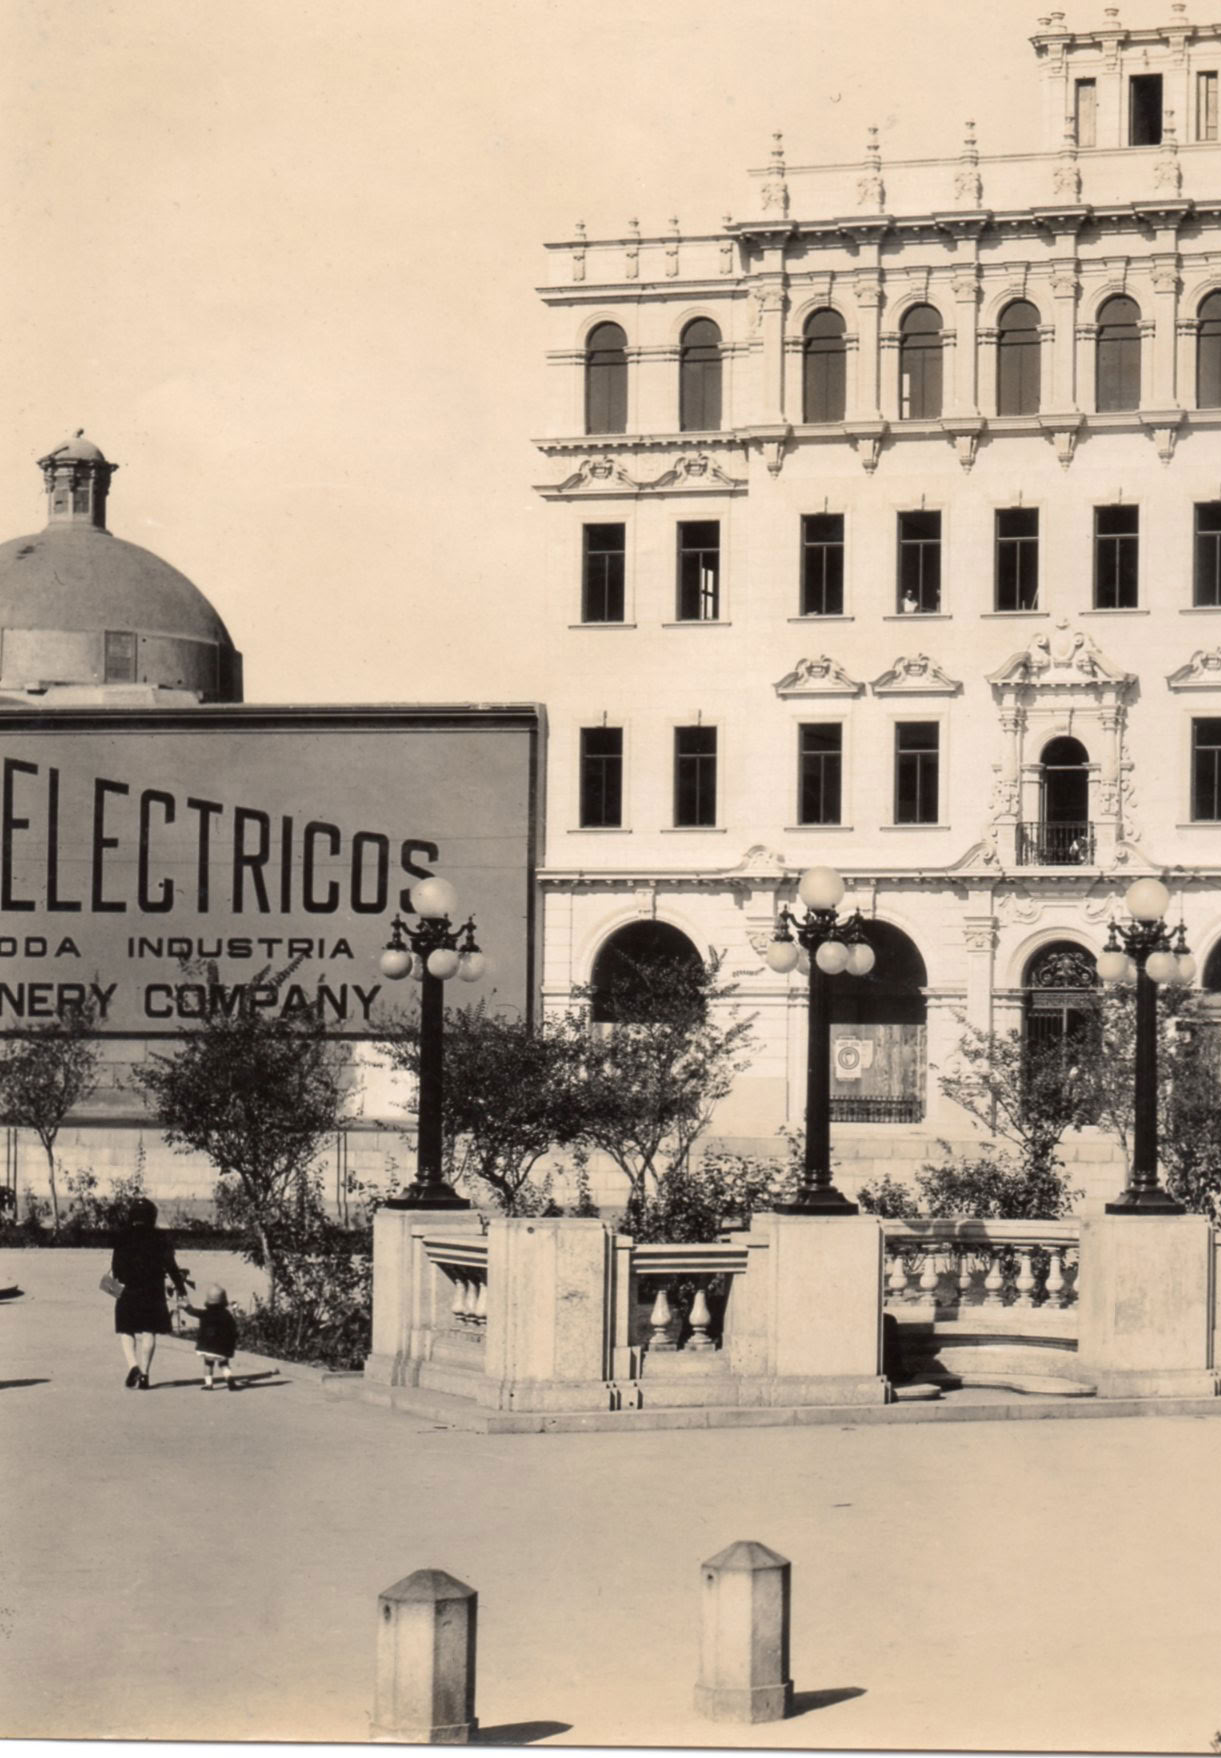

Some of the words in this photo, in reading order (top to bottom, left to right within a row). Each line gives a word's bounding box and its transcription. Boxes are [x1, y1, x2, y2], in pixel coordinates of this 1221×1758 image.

[2, 757, 440, 915] ELECTRICOS
[127, 936, 354, 960] INDUSTRIA
[0, 982, 118, 1018] NERY
[144, 983, 382, 1019] COMPANY
